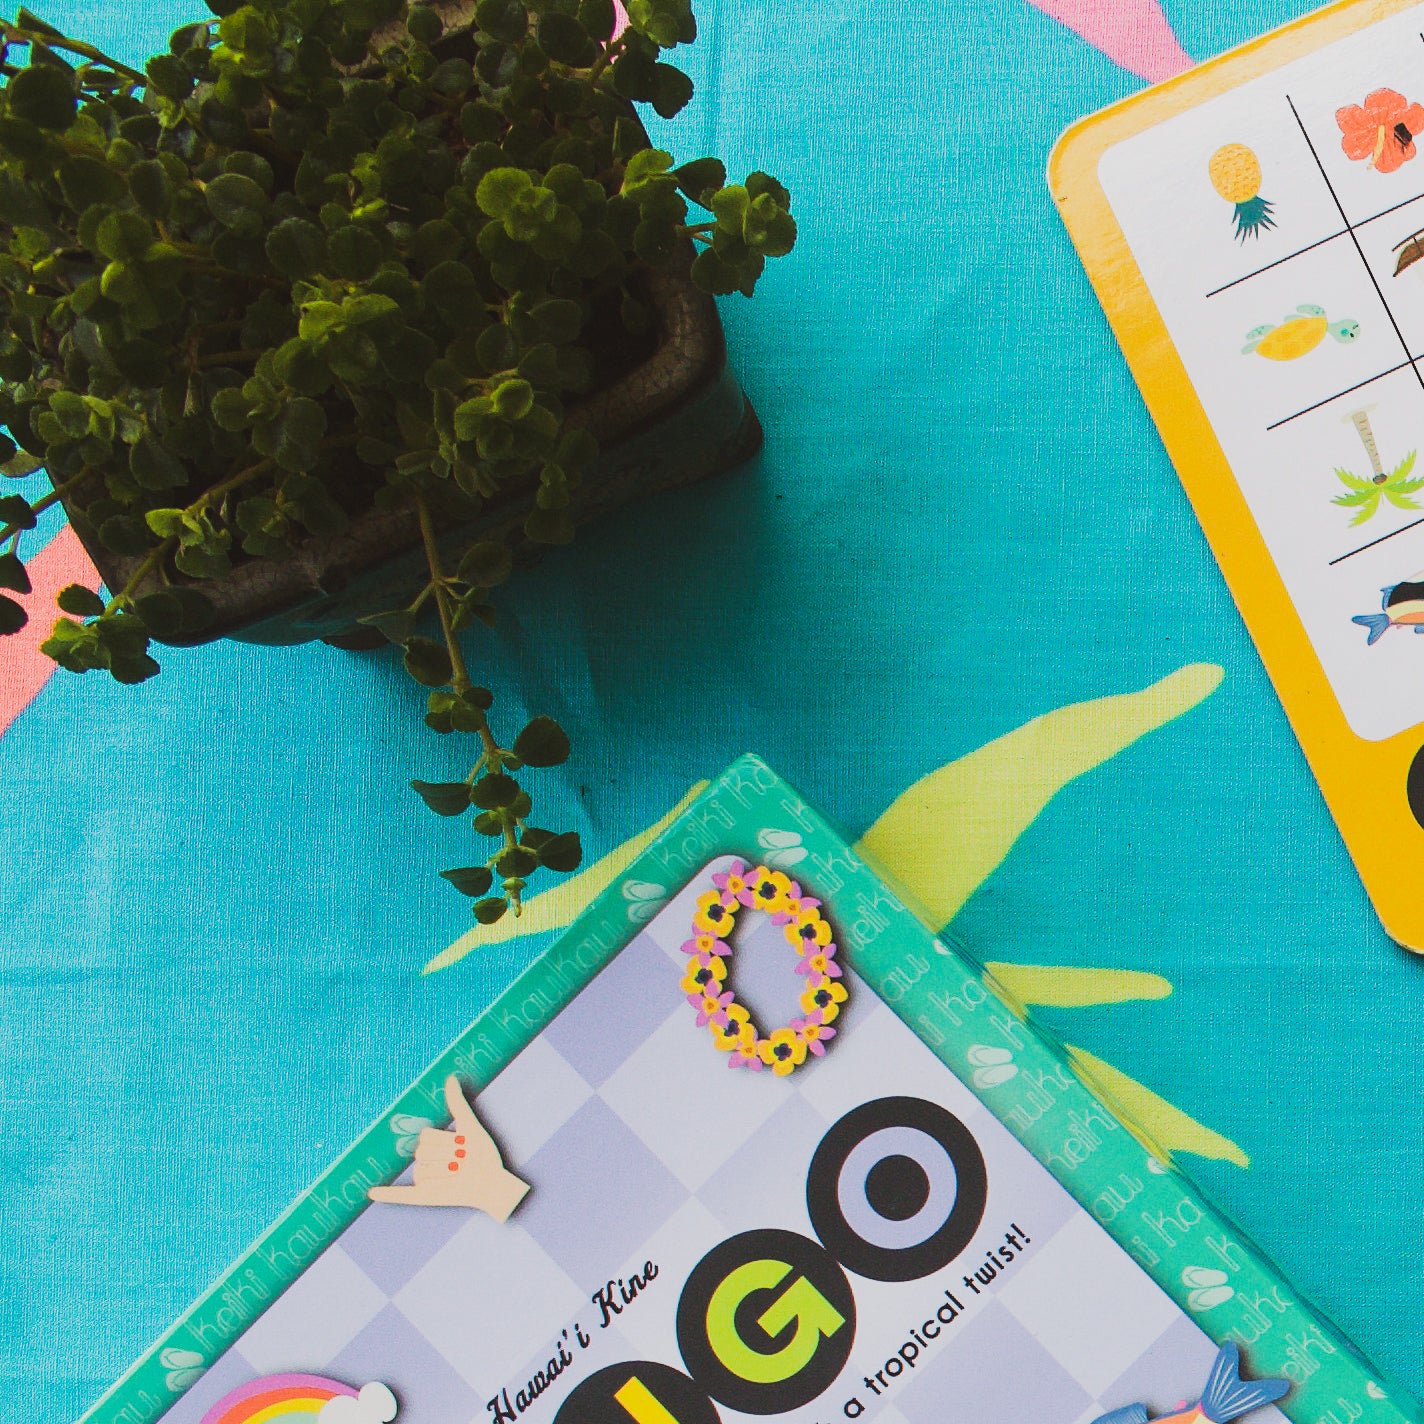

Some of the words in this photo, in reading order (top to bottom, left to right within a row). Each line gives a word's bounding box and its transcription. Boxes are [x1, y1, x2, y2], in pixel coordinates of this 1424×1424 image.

[591, 1260, 659, 1329] Kine
[843, 1397, 866, 1419] a
[863, 1289, 965, 1396] tropical
[962, 1223, 1031, 1295] twist!
